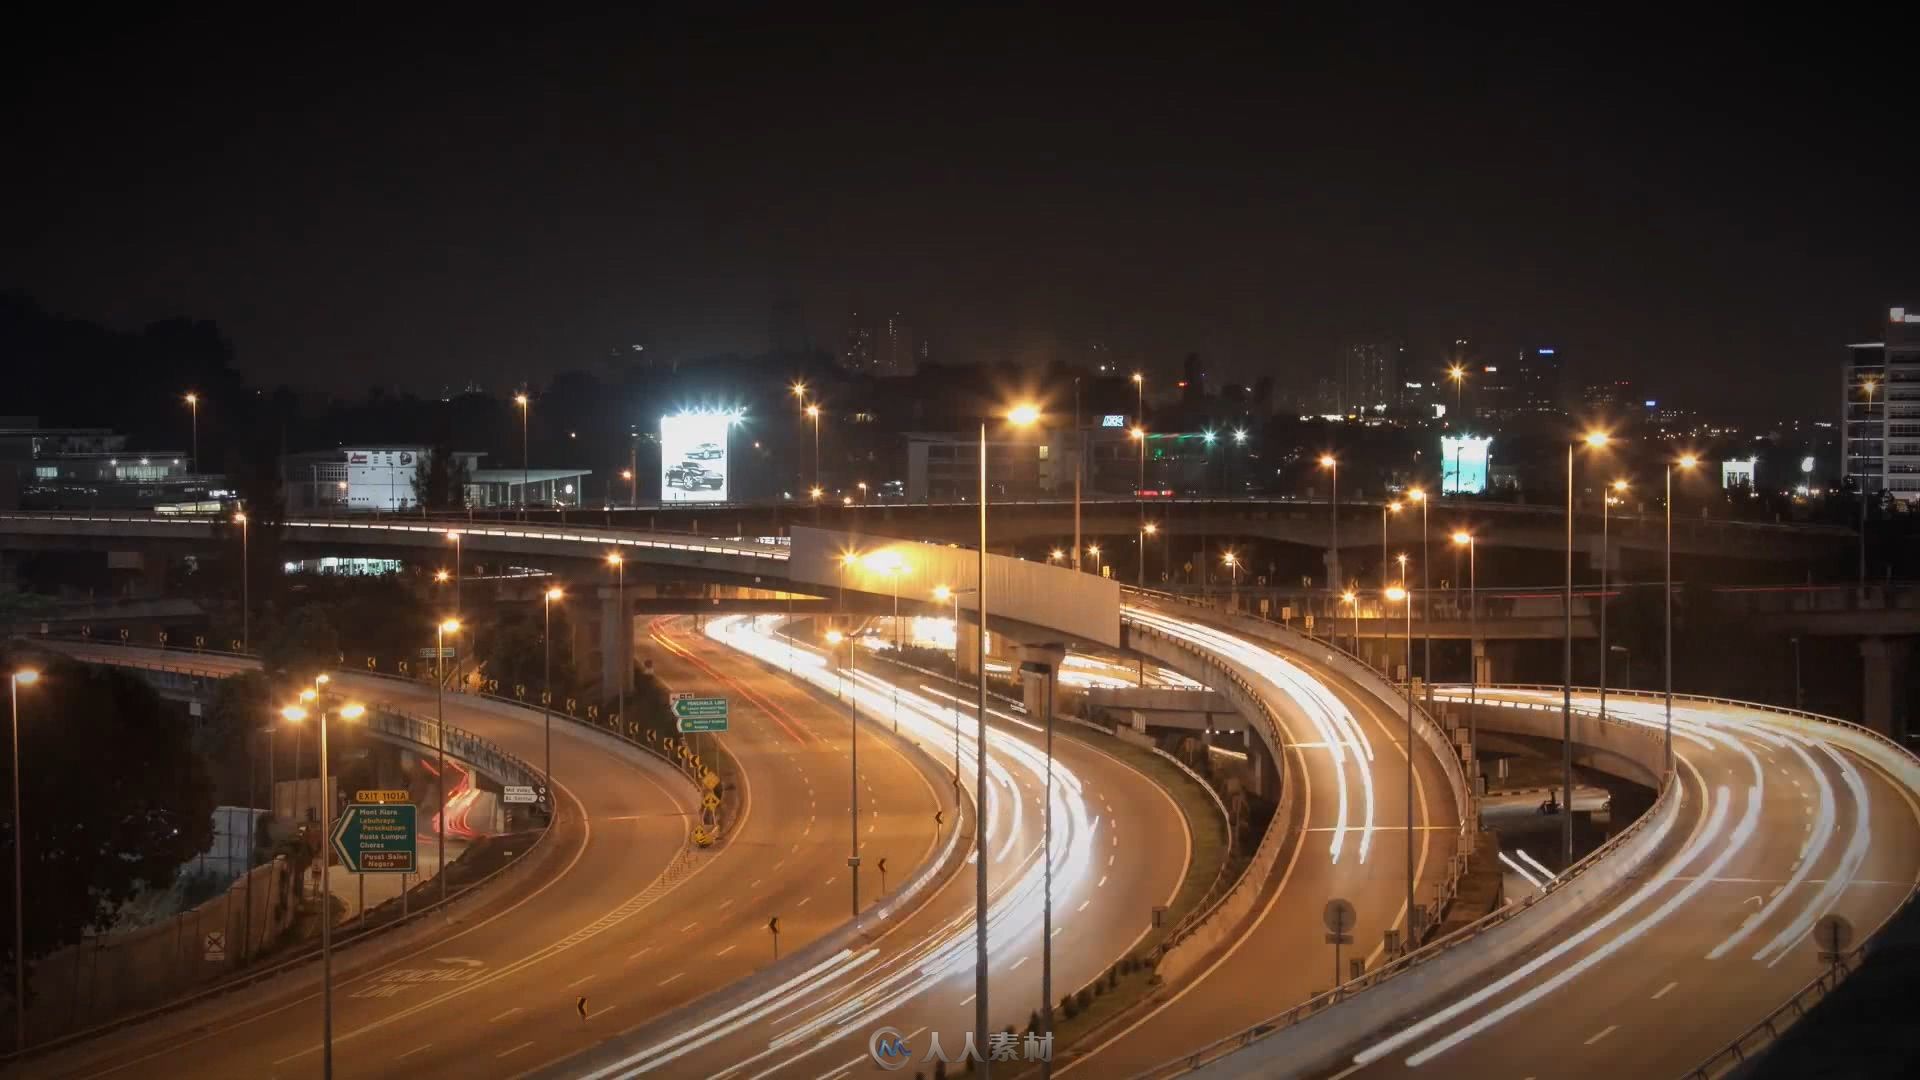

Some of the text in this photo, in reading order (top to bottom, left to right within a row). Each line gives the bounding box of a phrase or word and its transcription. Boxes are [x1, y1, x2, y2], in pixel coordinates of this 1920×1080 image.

[358, 792, 406, 800] EXIT 1101A
[360, 808, 397, 816] Mont Kiara
[360, 817, 395, 825] Lebuhraya
[381, 833, 407, 841] Lumpur
